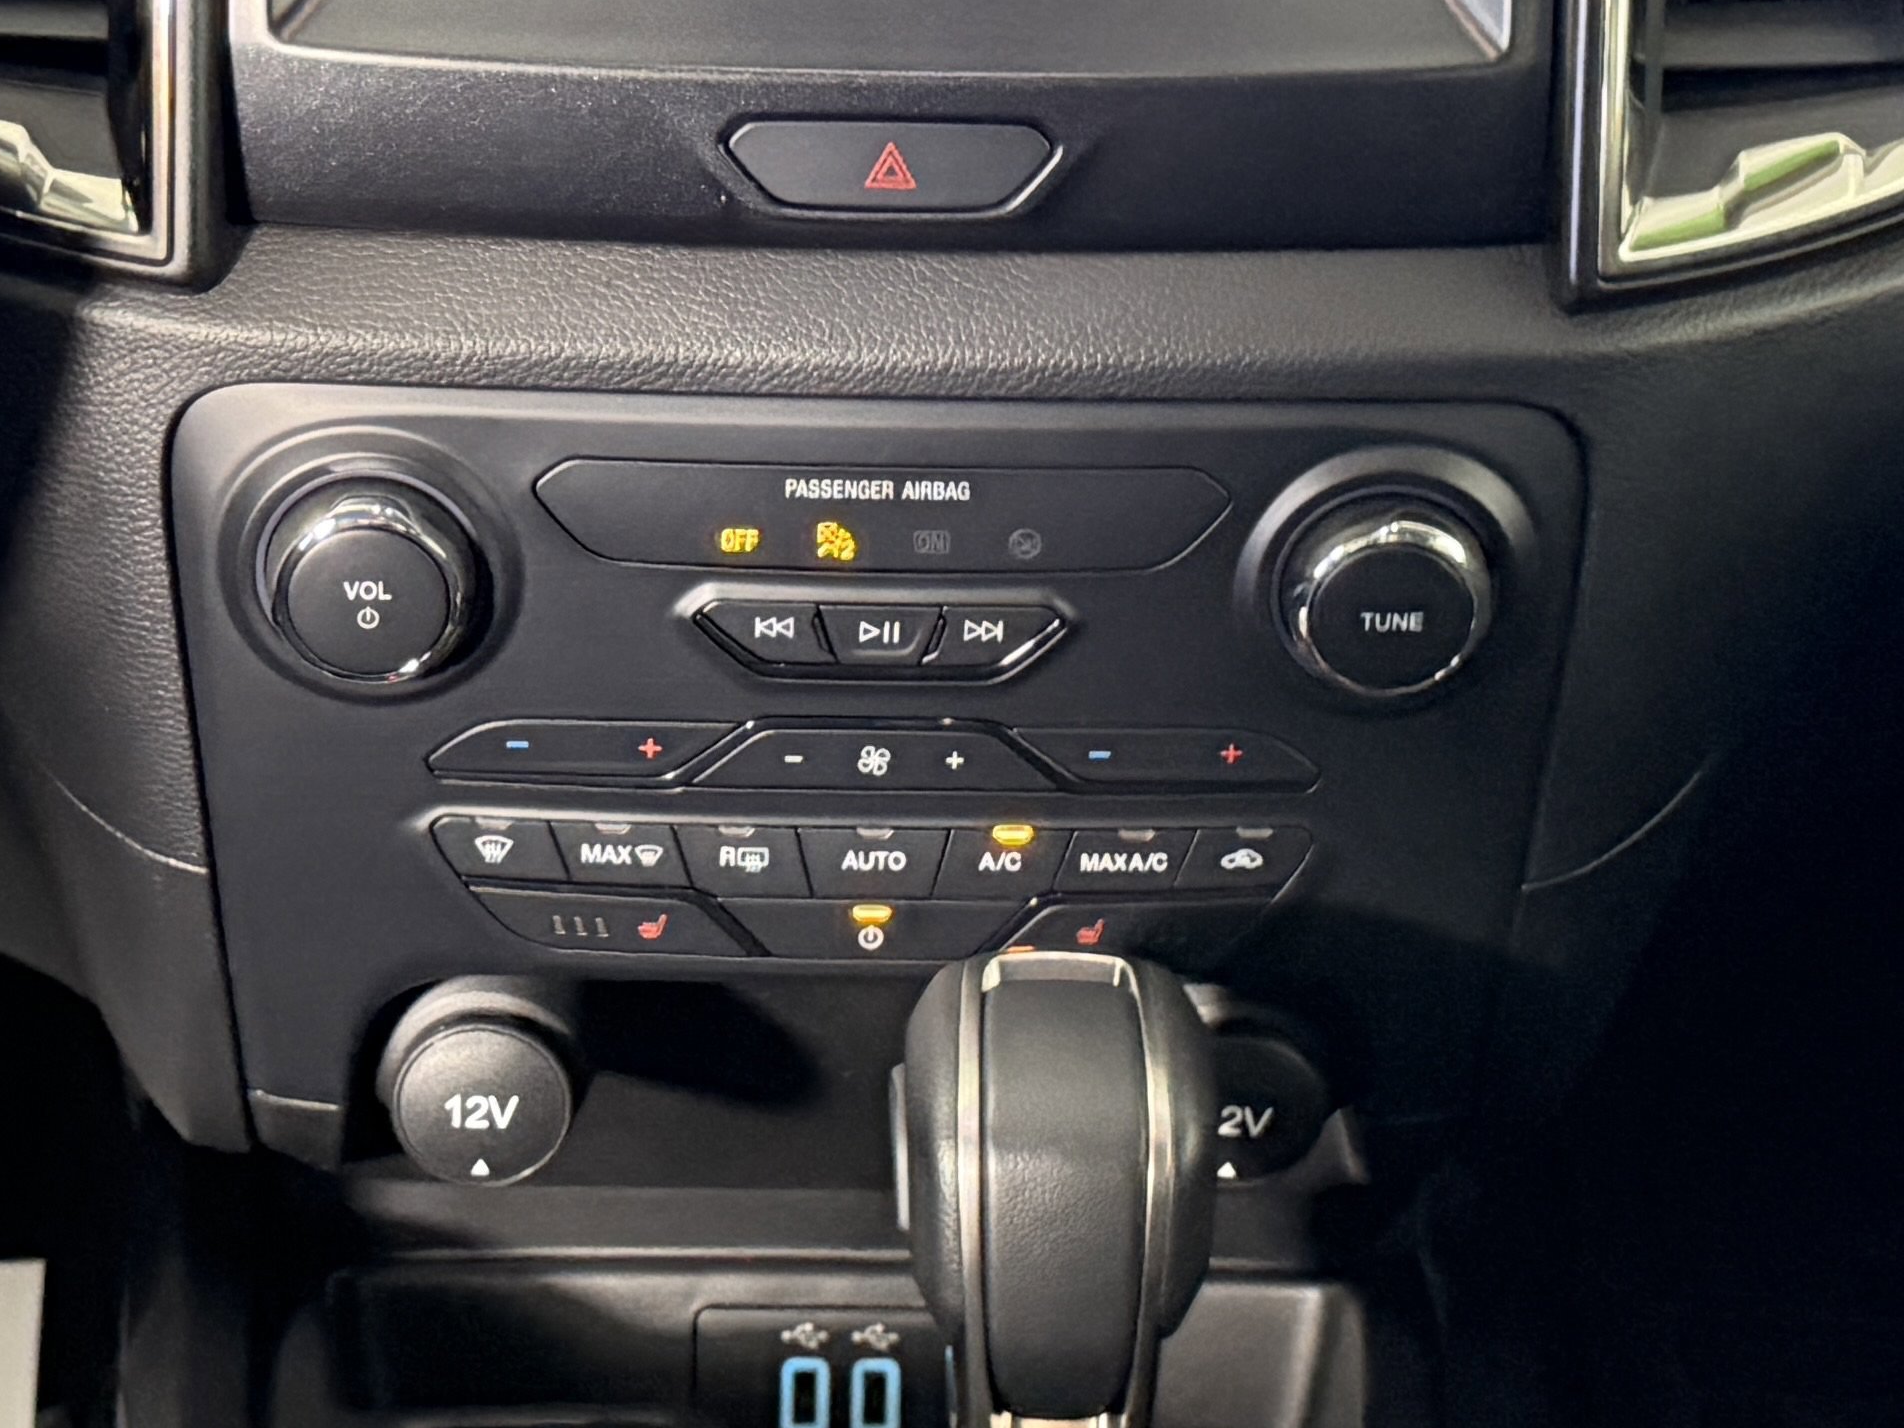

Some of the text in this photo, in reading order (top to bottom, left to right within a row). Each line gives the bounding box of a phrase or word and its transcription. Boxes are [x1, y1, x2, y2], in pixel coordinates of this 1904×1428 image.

[784, 477, 971, 503] PASSENGER AIRBAG
[719, 527, 760, 553] OFF
[343, 580, 393, 601] VOL
[1360, 611, 1424, 633] TUNE
[580, 843, 632, 865] MAX
[841, 849, 907, 872] AUTO
[978, 850, 1022, 872] A/C
[443, 1093, 520, 1130] 12V
[1217, 1104, 1274, 1139] 2V
